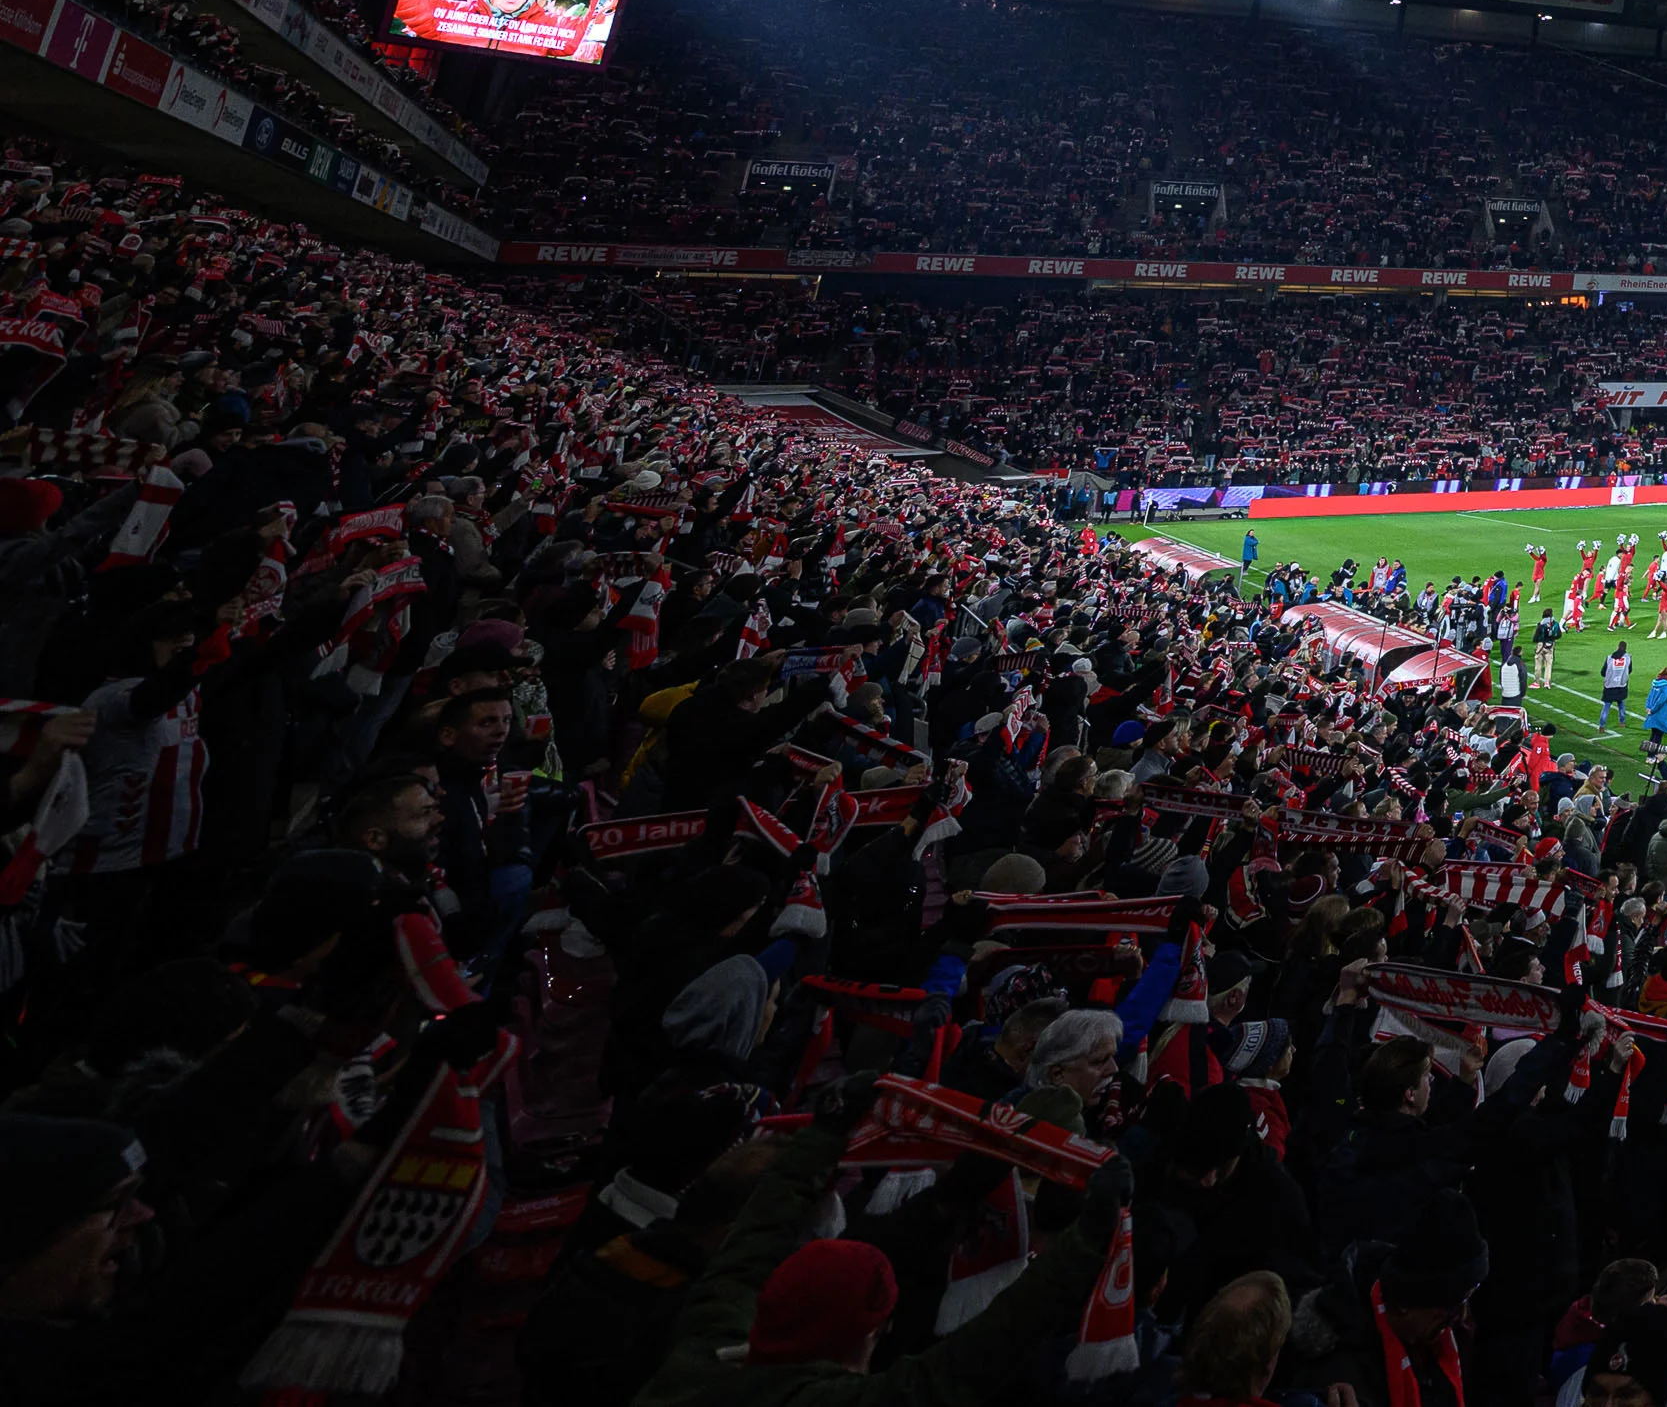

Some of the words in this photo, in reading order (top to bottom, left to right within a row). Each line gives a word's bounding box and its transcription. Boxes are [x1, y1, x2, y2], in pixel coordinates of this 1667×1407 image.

[468, 13, 488, 25] ODER
[538, 22, 558, 36] ODER
[437, 21, 476, 37] ZESAMME
[508, 33, 533, 45] STARK
[533, 36, 544, 47] FC
[281, 137, 310, 161] BULLS
[751, 163, 789, 178] Gaffel
[790, 164, 832, 180] Kölsch
[1154, 183, 1186, 197] Gaffel
[537, 245, 609, 263] REWE
[916, 256, 976, 273] REWE
[1028, 259, 1085, 276] REWE
[1134, 263, 1188, 278] REWE
[1235, 266, 1286, 281] REWE
[1331, 269, 1379, 283] REWE
[1421, 272, 1467, 286] REWE
[1508, 274, 1551, 288] REWE
[355, 1274, 421, 1306] KÖLN
